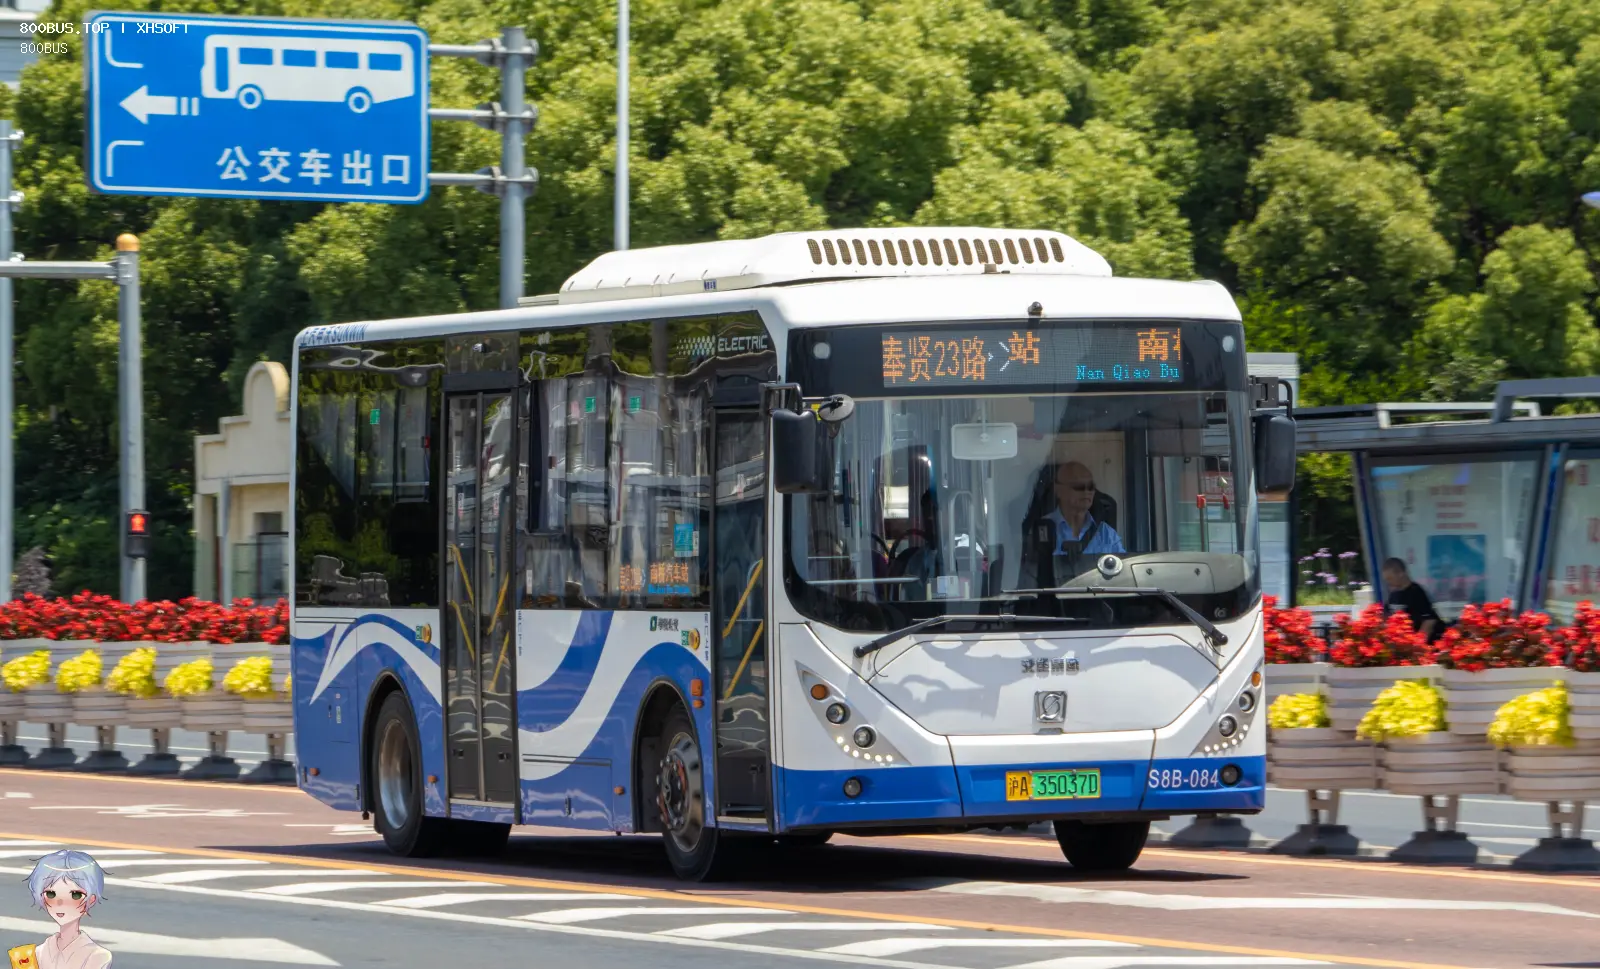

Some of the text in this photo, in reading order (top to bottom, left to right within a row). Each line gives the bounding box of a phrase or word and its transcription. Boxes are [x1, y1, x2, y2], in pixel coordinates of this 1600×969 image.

[216, 145, 410, 187] 公交车出口
[717, 334, 768, 352] ELECTRIC
[882, 331, 1041, 384] 奉贤23路 站
[1075, 363, 1180, 380] Nan Qiao Bu
[1148, 768, 1219, 789] S8B-084
